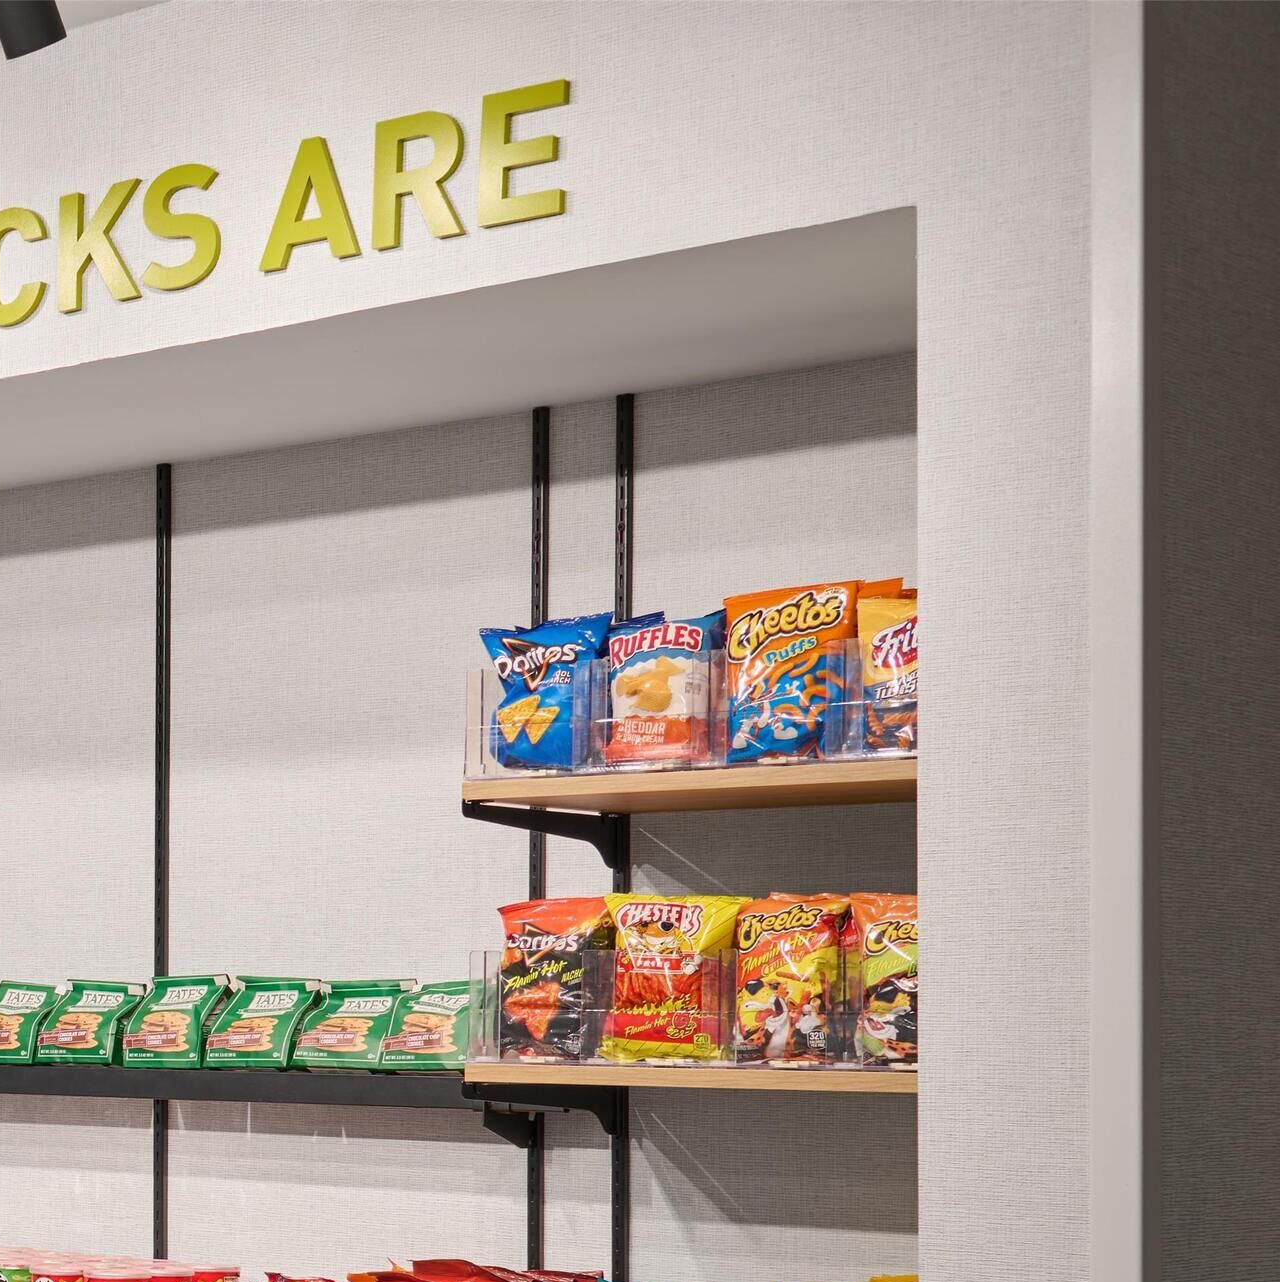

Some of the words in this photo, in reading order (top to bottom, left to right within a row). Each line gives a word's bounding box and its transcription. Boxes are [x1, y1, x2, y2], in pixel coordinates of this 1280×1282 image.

[261, 80, 570, 272] ARE
[727, 591, 846, 663] Cheetos
[609, 624, 702, 668] RUFFLES
[763, 635, 816, 665] Puffs
[494, 643, 577, 680] Doritos
[617, 903, 703, 937] CHESTER'S
[739, 905, 824, 952] Cheetos
[541, 960, 568, 975] Hot
[7, 992, 44, 1003] TATE'S
[84, 992, 122, 1005] TATE'S
[168, 988, 205, 1000] TATE'S
[256, 993, 295, 1004] TATE'S
[346, 1000, 389, 1011] TATE'S
[654, 1017, 670, 1028] Hot
[809, 1032, 825, 1041] 320
